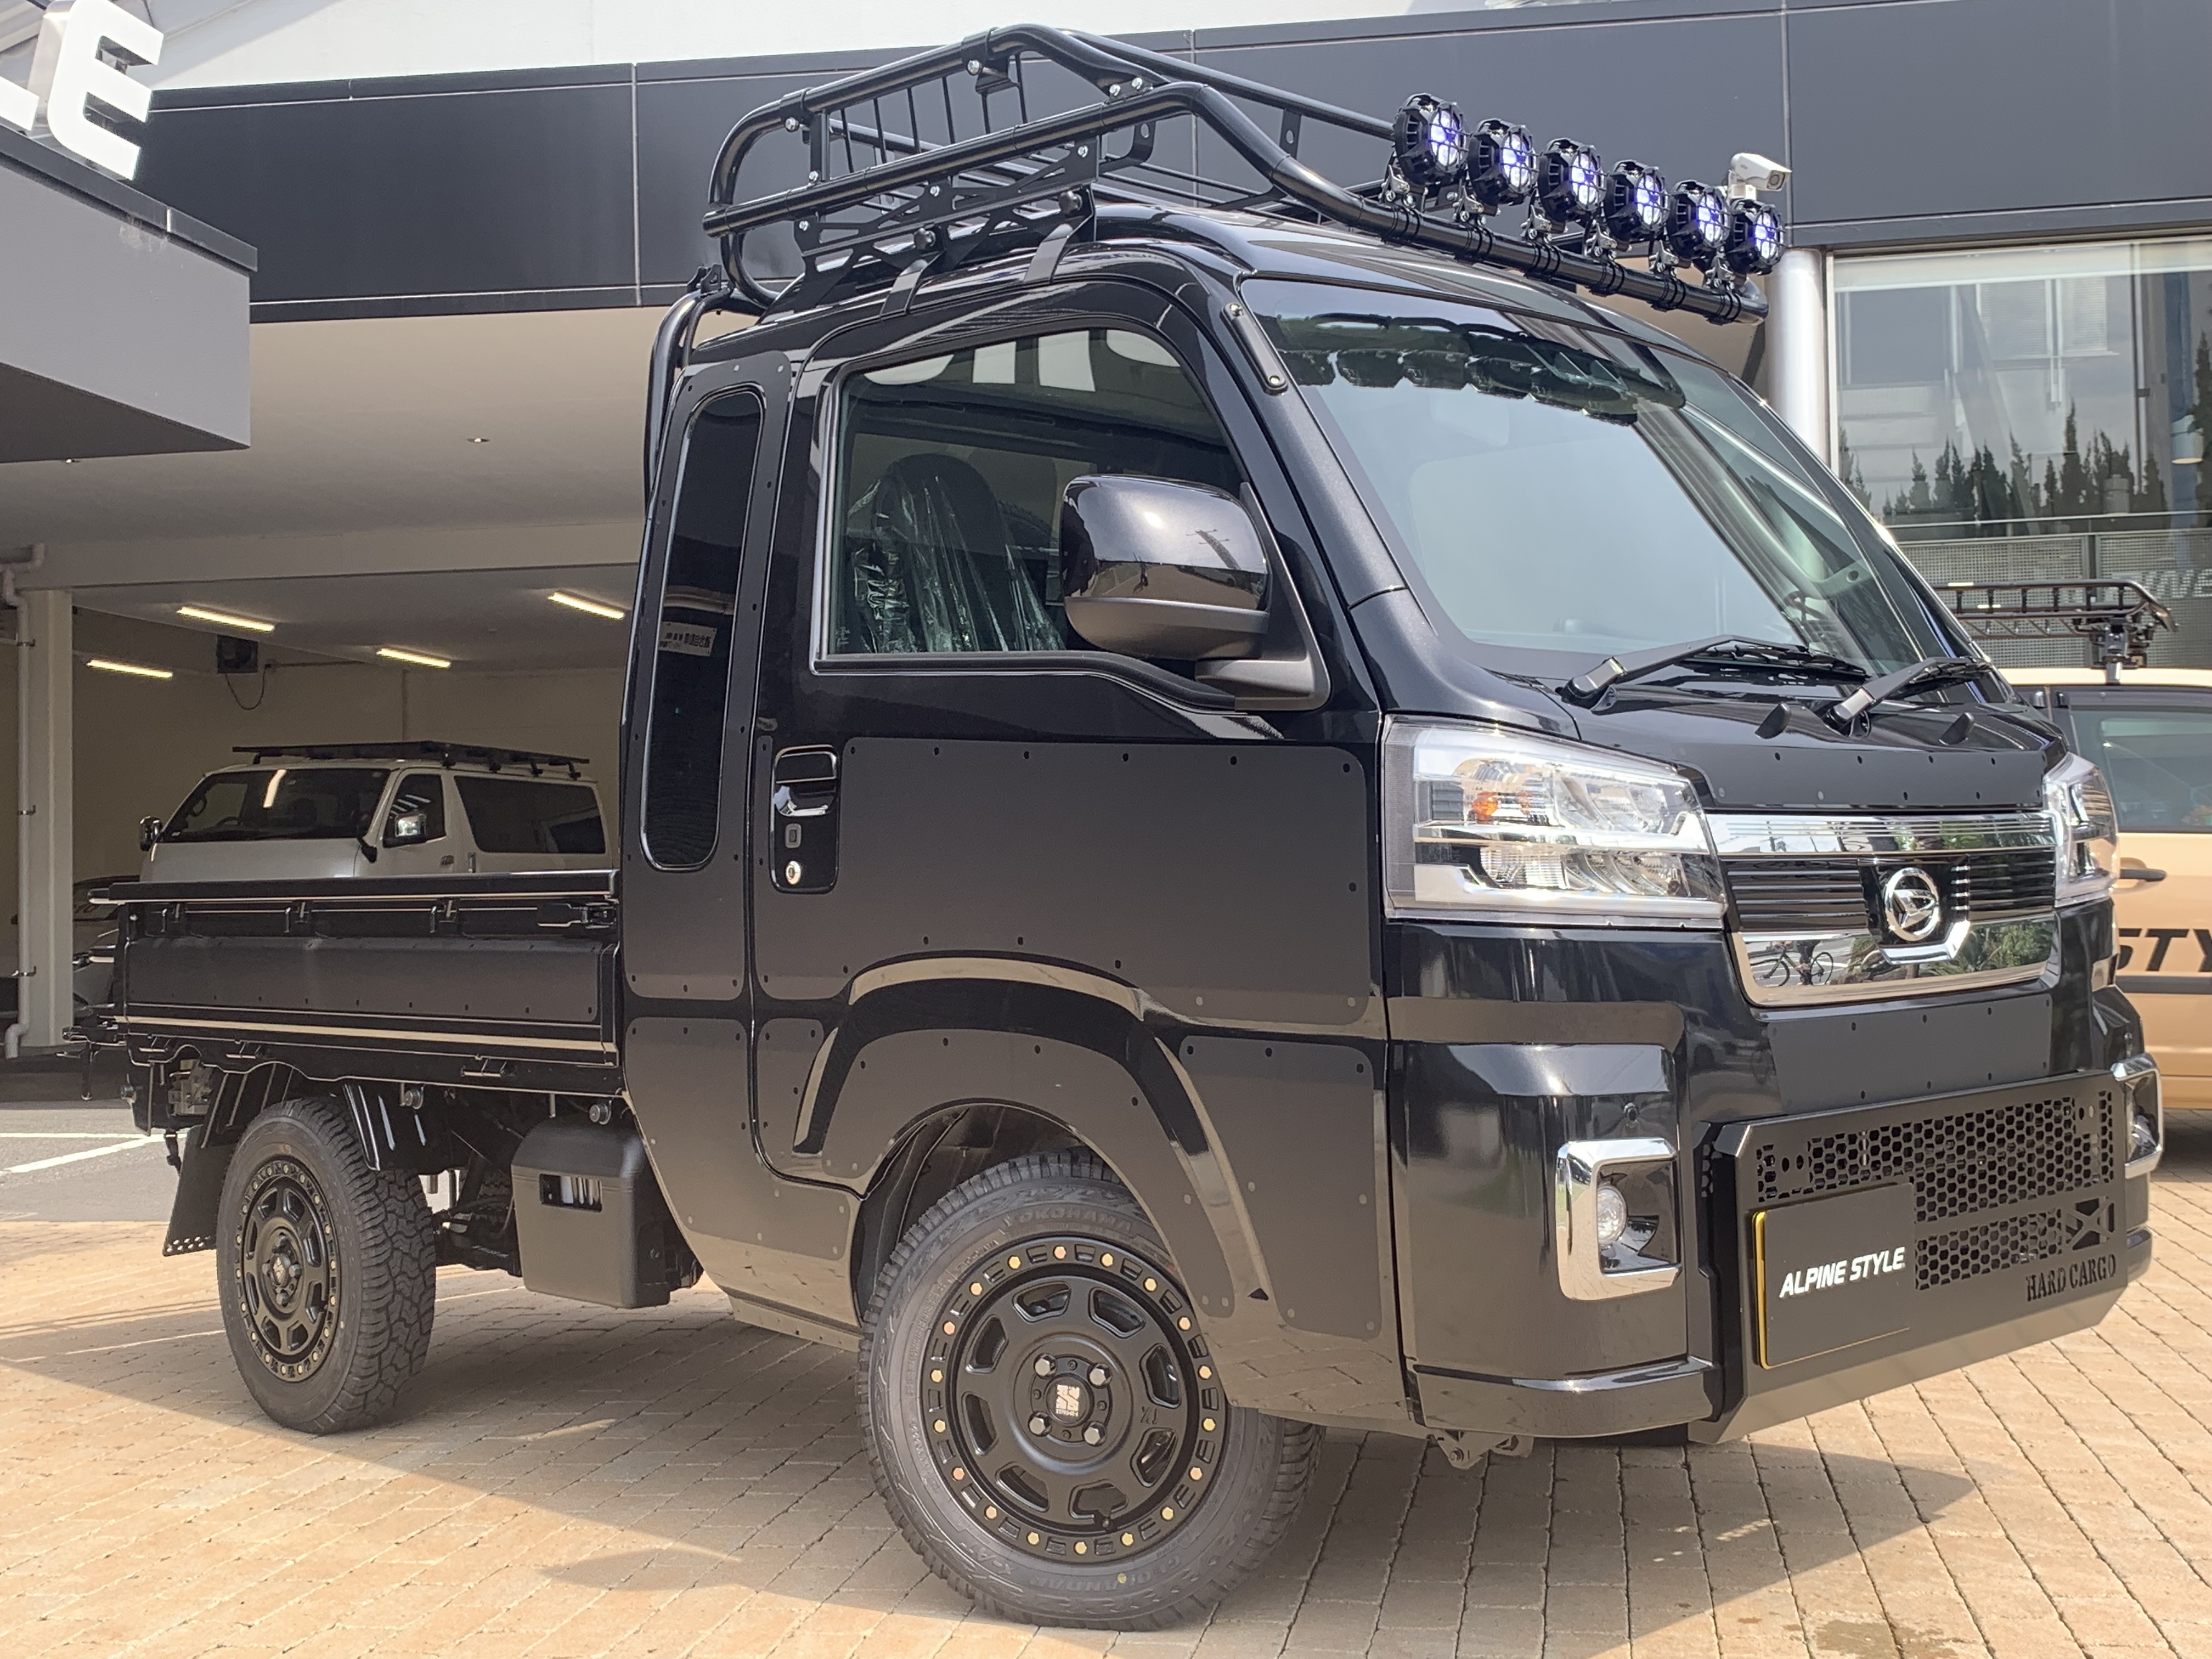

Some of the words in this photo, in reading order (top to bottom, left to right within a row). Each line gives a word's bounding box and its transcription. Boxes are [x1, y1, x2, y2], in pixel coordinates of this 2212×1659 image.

[1003, 1206, 1132, 1232] YOKOHAMA
[1779, 1260, 1847, 1298] ALPINE
[1849, 1247, 1905, 1281] STYLE
[2025, 1267, 2066, 1302] HARD
[2069, 1254, 2116, 1289] CARGO
